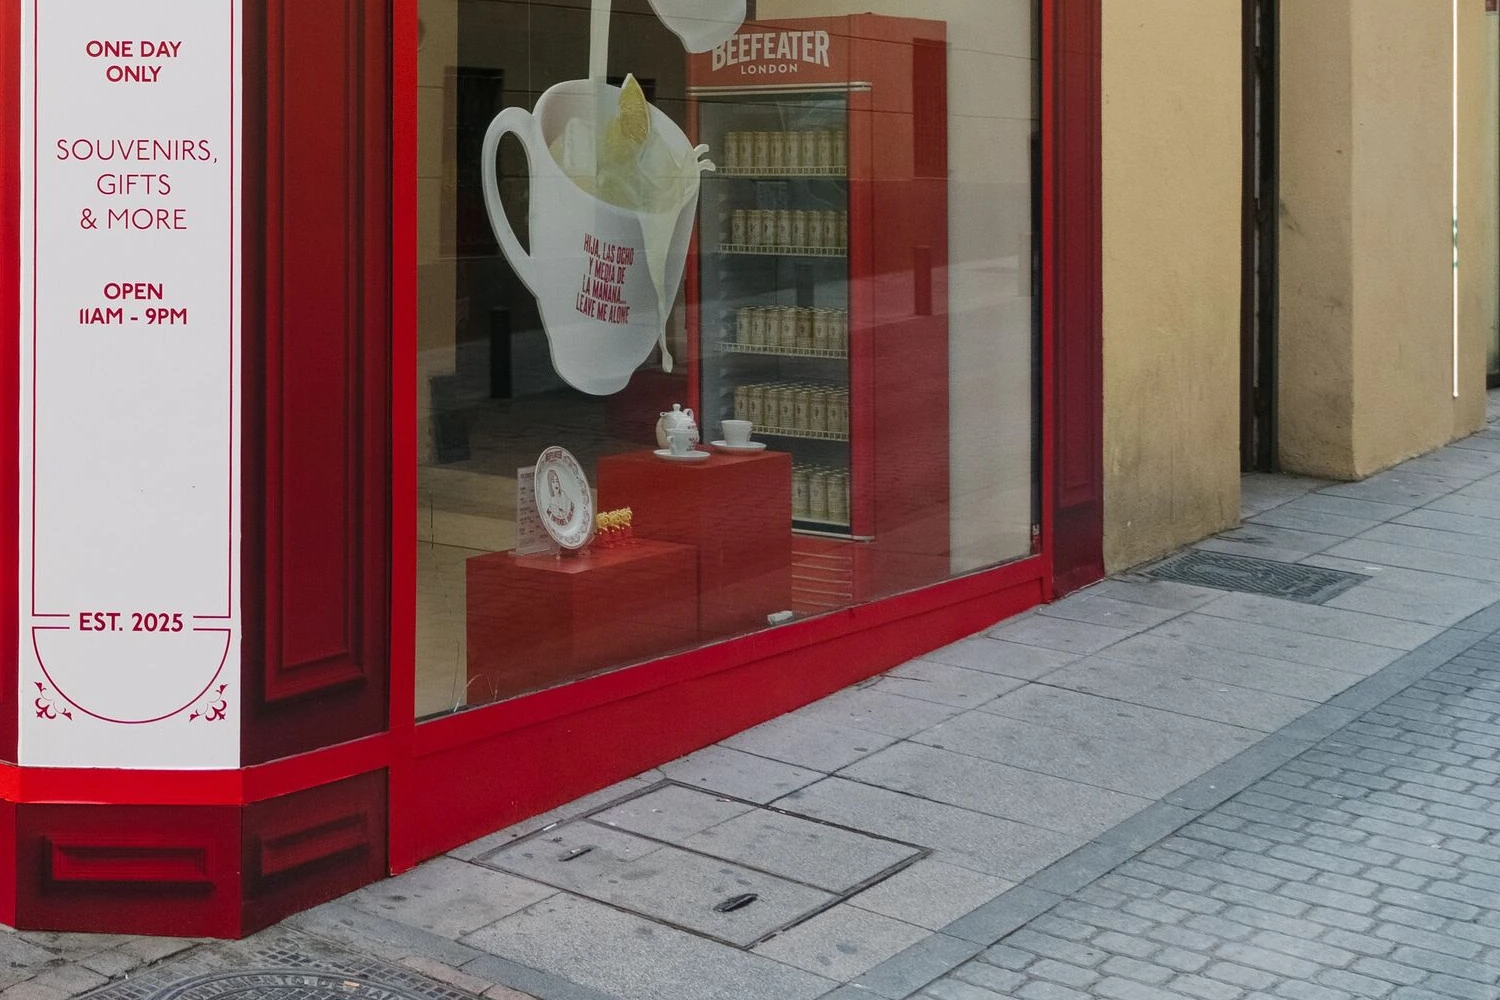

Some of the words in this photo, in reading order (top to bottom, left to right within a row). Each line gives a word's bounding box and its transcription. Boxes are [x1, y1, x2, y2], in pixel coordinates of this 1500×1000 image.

[85, 40, 133, 58] ONE
[140, 40, 182, 58] DAY
[711, 30, 830, 72] BEEFEATER
[105, 65, 162, 83] ONLY
[741, 63, 798, 75] LONDON
[56, 138, 218, 164] SOUVENIRS,
[96, 173, 172, 196] GIFTS
[79, 207, 98, 230] &
[107, 208, 188, 230] MORE
[602, 242, 616, 263] LAS
[616, 246, 635, 266] OCHO
[588, 256, 594, 275] Y
[595, 259, 616, 283] MEDIA
[617, 266, 626, 285] DE
[103, 282, 163, 301] OPEN
[582, 273, 591, 296] LA
[78, 307, 123, 325] 11AM
[145, 307, 188, 325] 9PM
[575, 292, 596, 318] LEAVE
[596, 301, 608, 322] ME
[608, 305, 631, 325] ALONE
[79, 612, 123, 632] EST.
[131, 612, 184, 633] 2025
